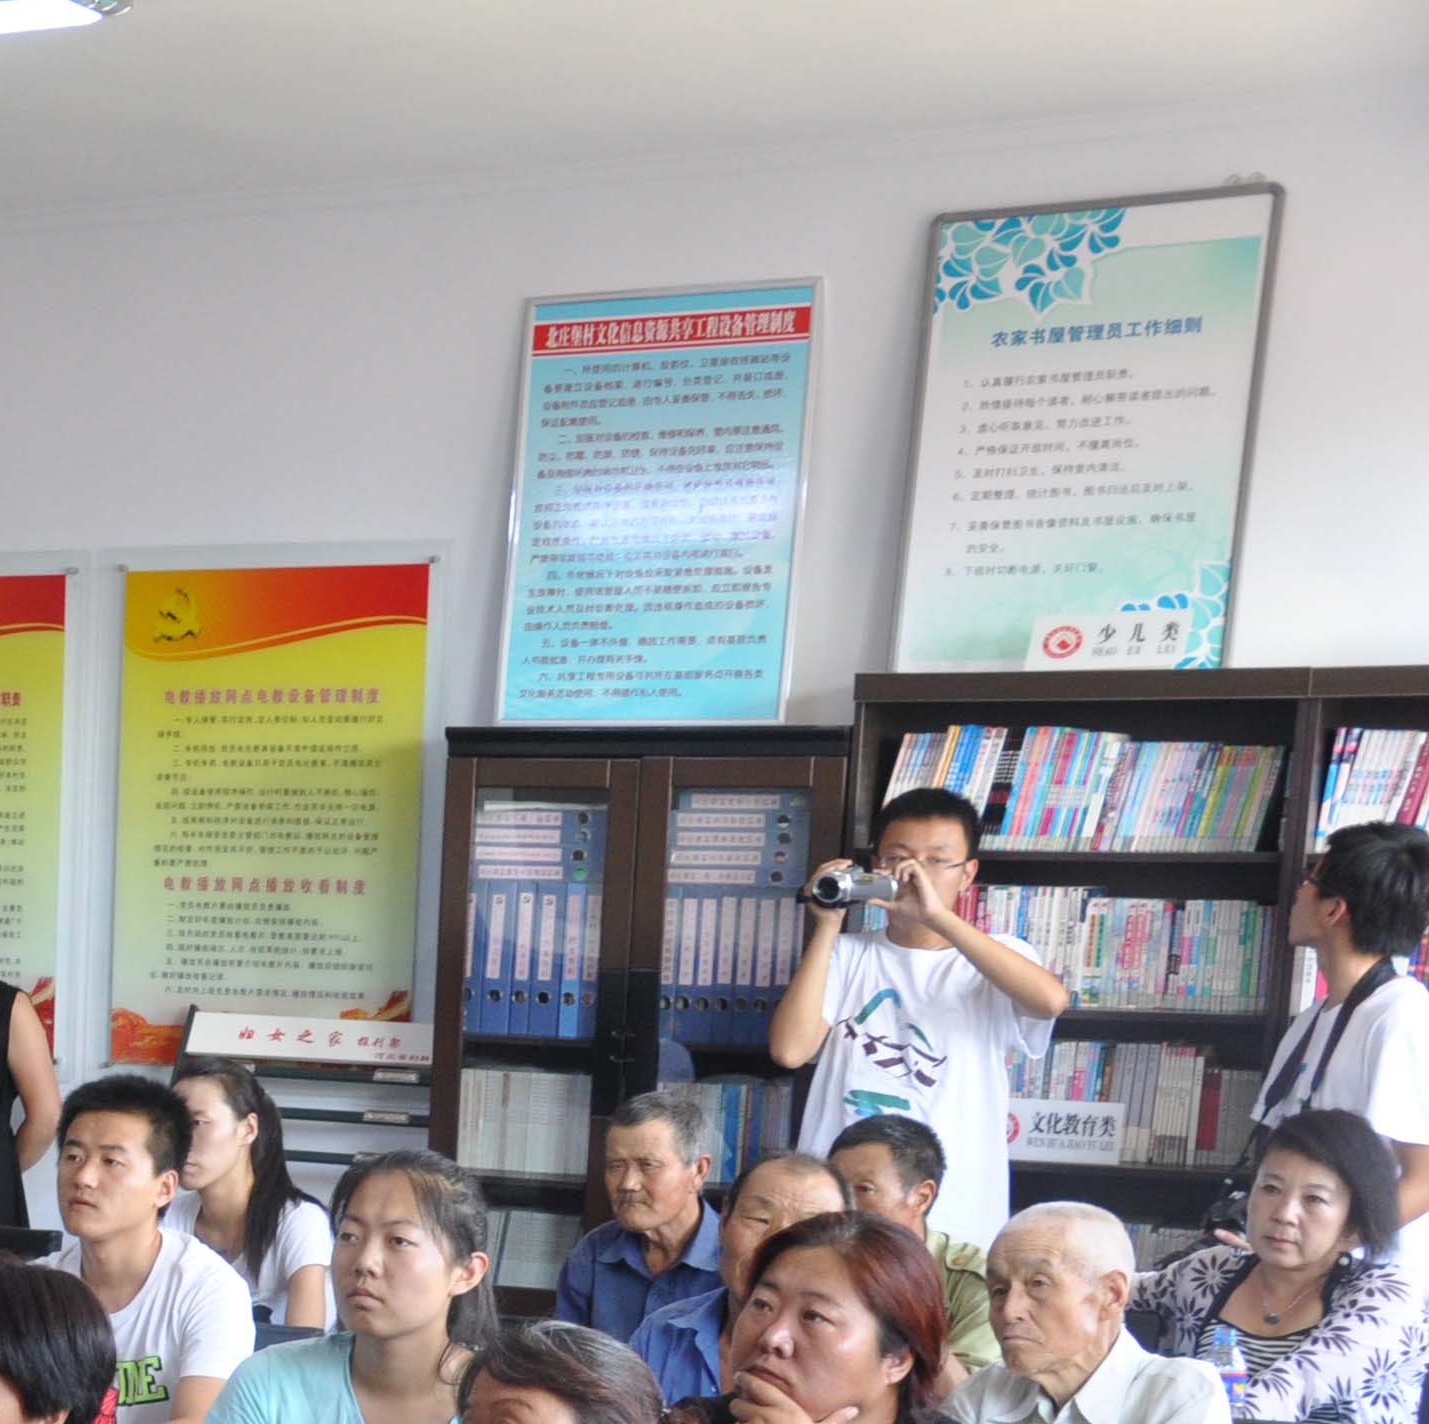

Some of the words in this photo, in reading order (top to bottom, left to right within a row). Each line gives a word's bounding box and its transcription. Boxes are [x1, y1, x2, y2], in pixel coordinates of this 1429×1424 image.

[545, 310, 796, 349] 北庄堡村文化信息资源共享工程设备管理制度
[990, 316, 1204, 348] 农家书屋管理员工作细则
[1098, 621, 1180, 645] 少儿类
[238, 1026, 344, 1048] 妇女之家
[1029, 1112, 1115, 1138] 文化教育类
